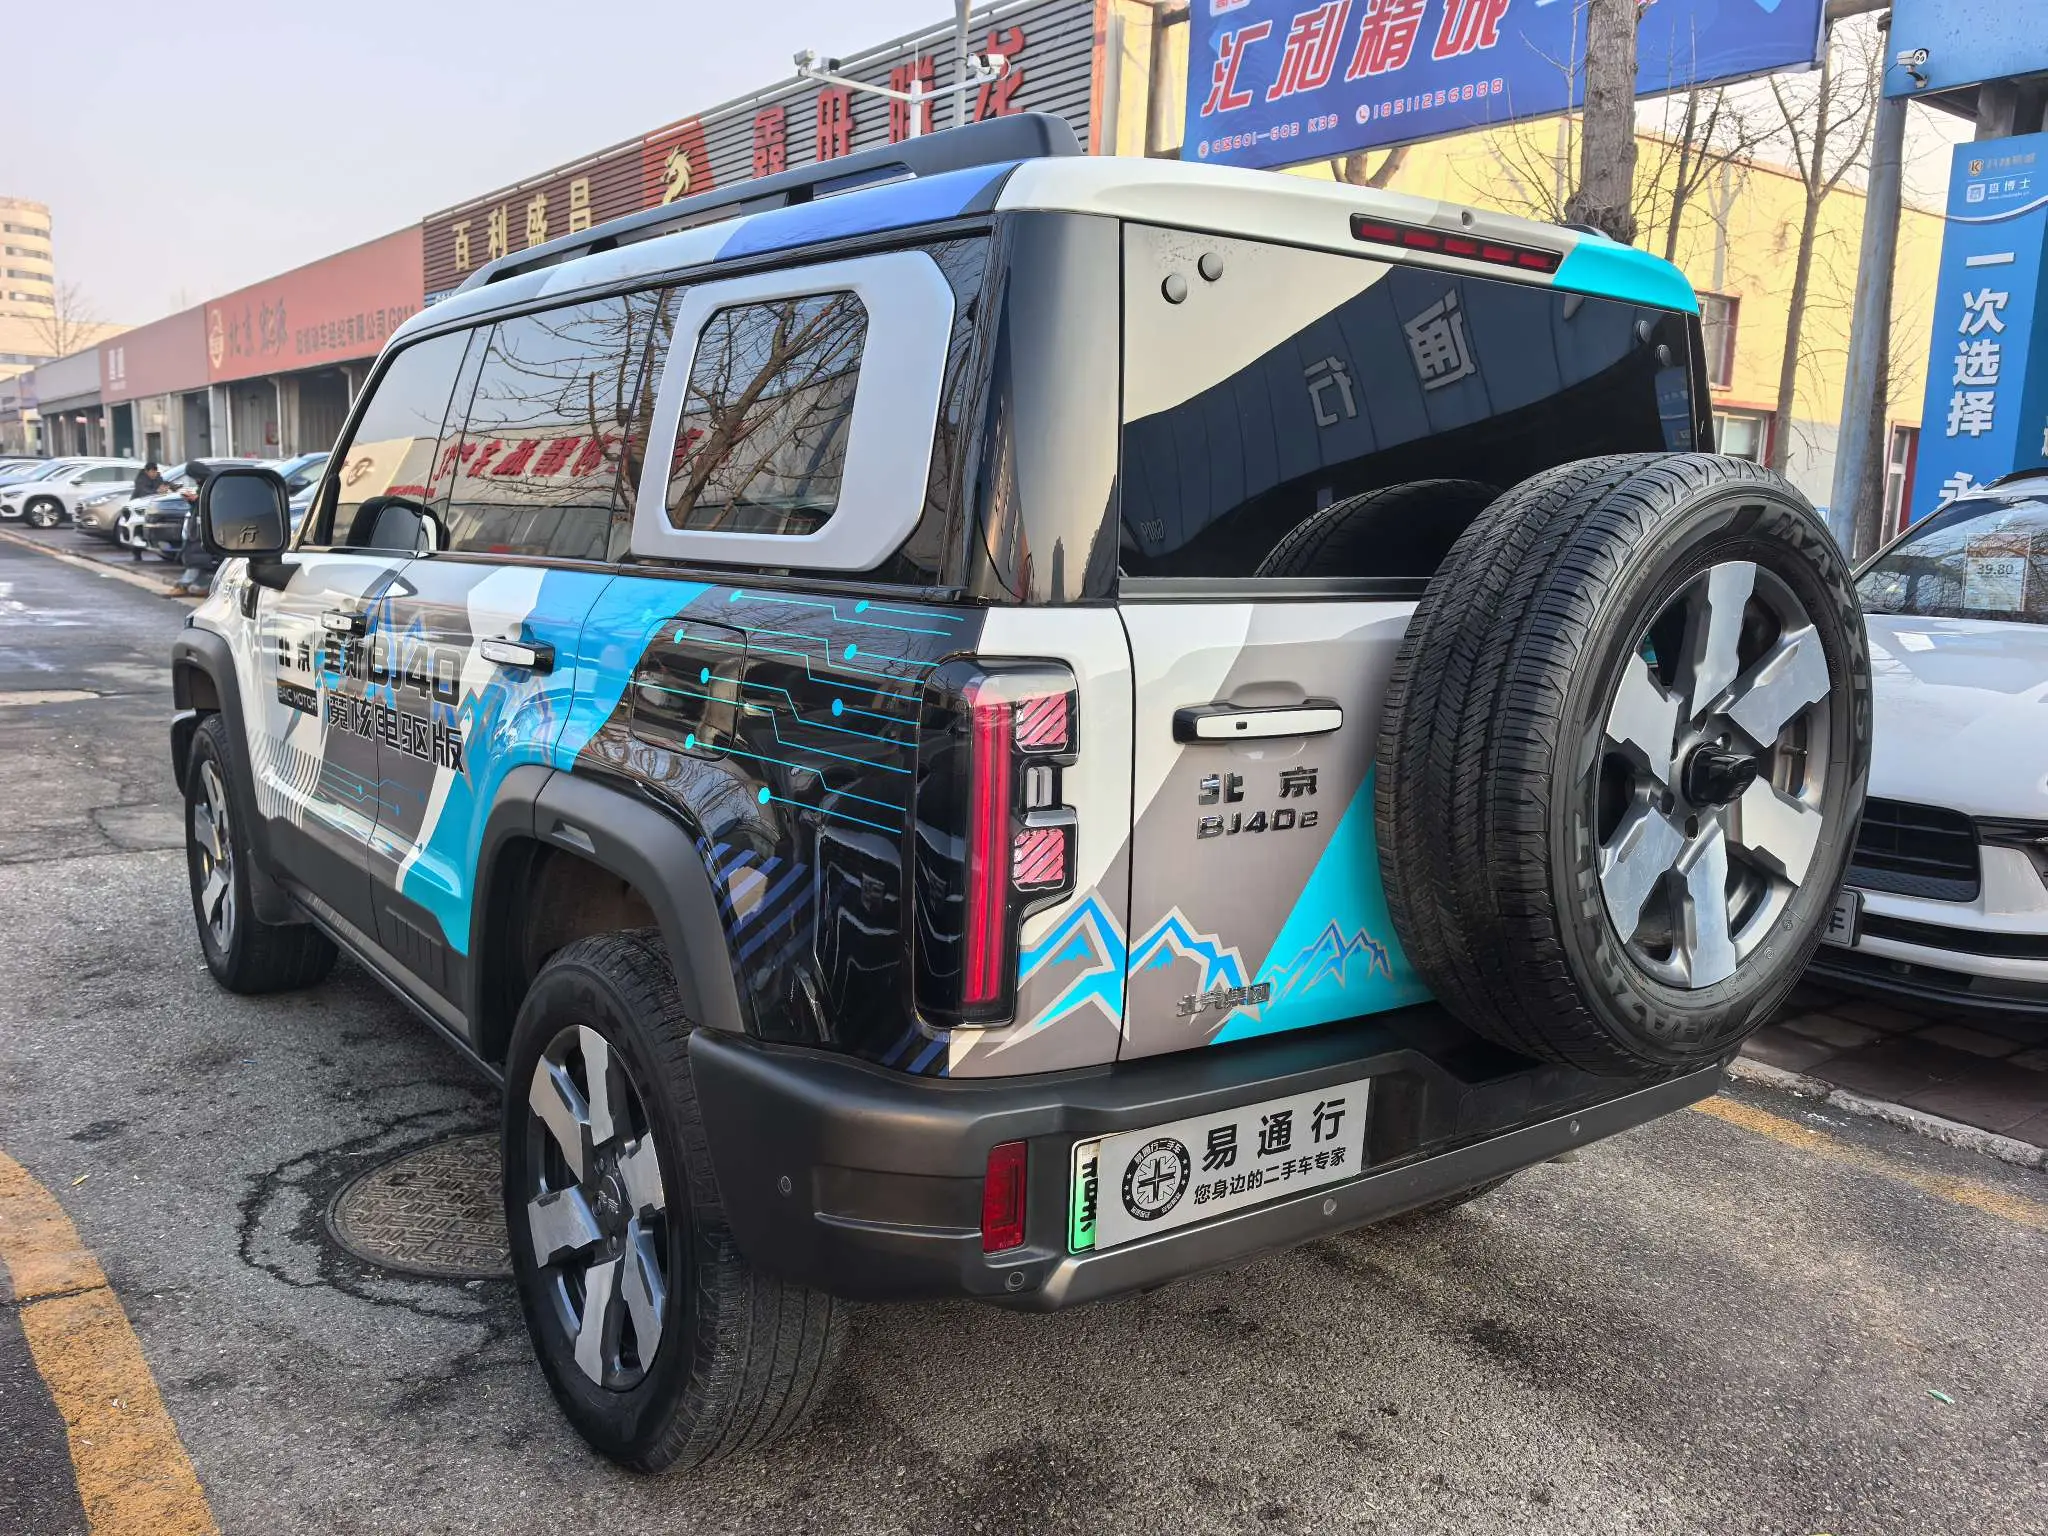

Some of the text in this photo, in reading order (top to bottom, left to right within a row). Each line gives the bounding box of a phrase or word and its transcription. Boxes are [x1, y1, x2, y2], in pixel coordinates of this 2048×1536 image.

[452, 176, 592, 271] 百利盛昌
[1198, 766, 1319, 805] 北京
[1202, 1098, 1346, 1173] 易通行
[1193, 1147, 1346, 1205] 您身边的二手车专家
